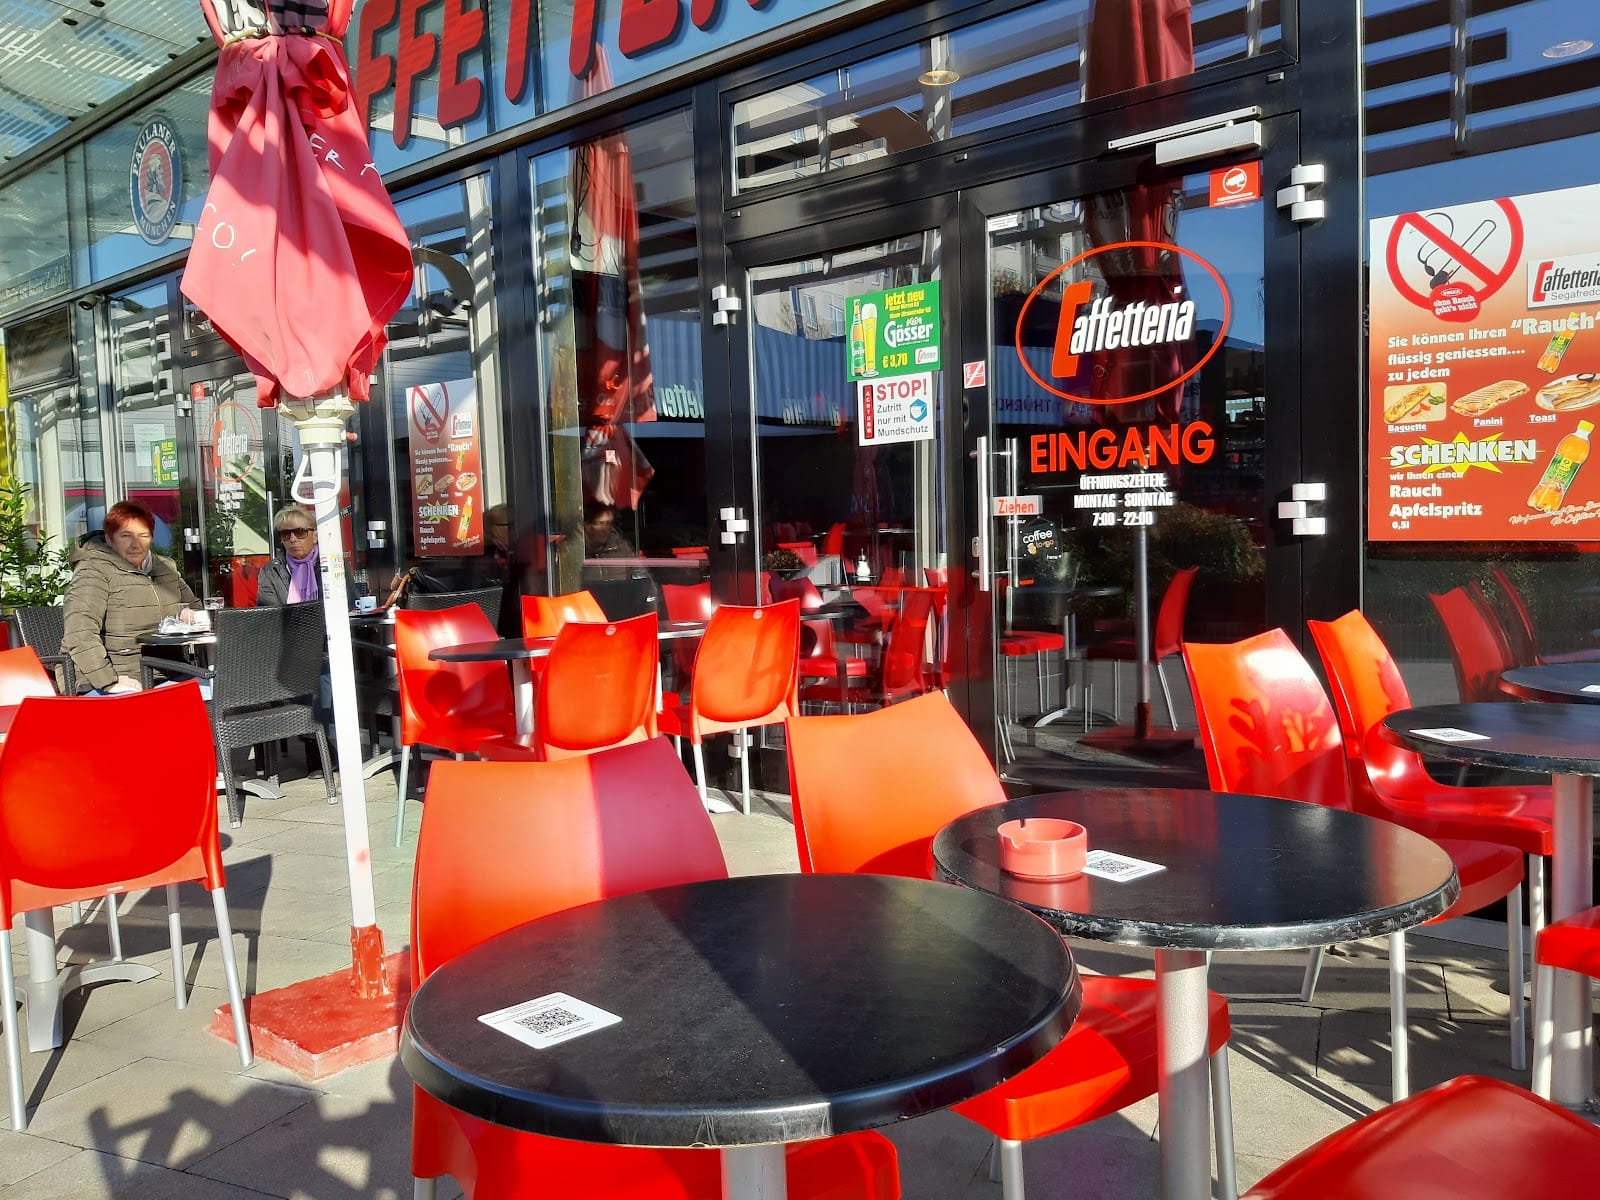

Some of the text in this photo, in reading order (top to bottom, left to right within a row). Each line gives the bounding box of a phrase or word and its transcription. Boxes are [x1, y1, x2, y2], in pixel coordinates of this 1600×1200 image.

[132, 123, 176, 176] PAULANER
[141, 200, 177, 237] MÜNCHEN
[907, 289, 925, 302] neu
[1433, 295, 1475, 307] ohne Rauch
[1458, 302, 1478, 311] nicht
[884, 320, 934, 348] Gösser
[1051, 281, 1195, 378] Caffetteria
[1388, 336, 1408, 349] Sie
[1411, 332, 1465, 346] können
[1468, 327, 1507, 340] Ihren
[882, 352, 908, 369] € 3,70
[1387, 346, 1526, 366] flüssig geniessen....
[1387, 366, 1450, 383] zu jedem
[876, 378, 927, 401] STOP!
[865, 391, 873, 434] ACHTUNG
[877, 402, 902, 414] Zutritt
[877, 415, 906, 425] nur mit
[1473, 417, 1503, 427] Panini
[1529, 414, 1557, 423] Toast
[878, 425, 929, 437] Mundschutz
[1387, 423, 1427, 433] Baguette
[1030, 420, 1215, 473] EINGANG
[1389, 439, 1537, 467] SCHENKEN
[1389, 472, 1404, 481] wir
[1406, 471, 1434, 480] Ihnen
[1389, 483, 1442, 498] Rauch
[998, 498, 1035, 514] Ziehen
[1073, 493, 1116, 509] MONTAG
[1124, 492, 1173, 508] SONNTAG
[419, 504, 459, 517] SCHENKEN
[1389, 502, 1483, 519] Apfelspritz
[1092, 512, 1115, 526] 7:00
[1123, 511, 1154, 526] 22:00
[1391, 520, 1410, 530] 0,5l
[420, 526, 435, 534] Rauch
[1022, 530, 1053, 544] coffee
